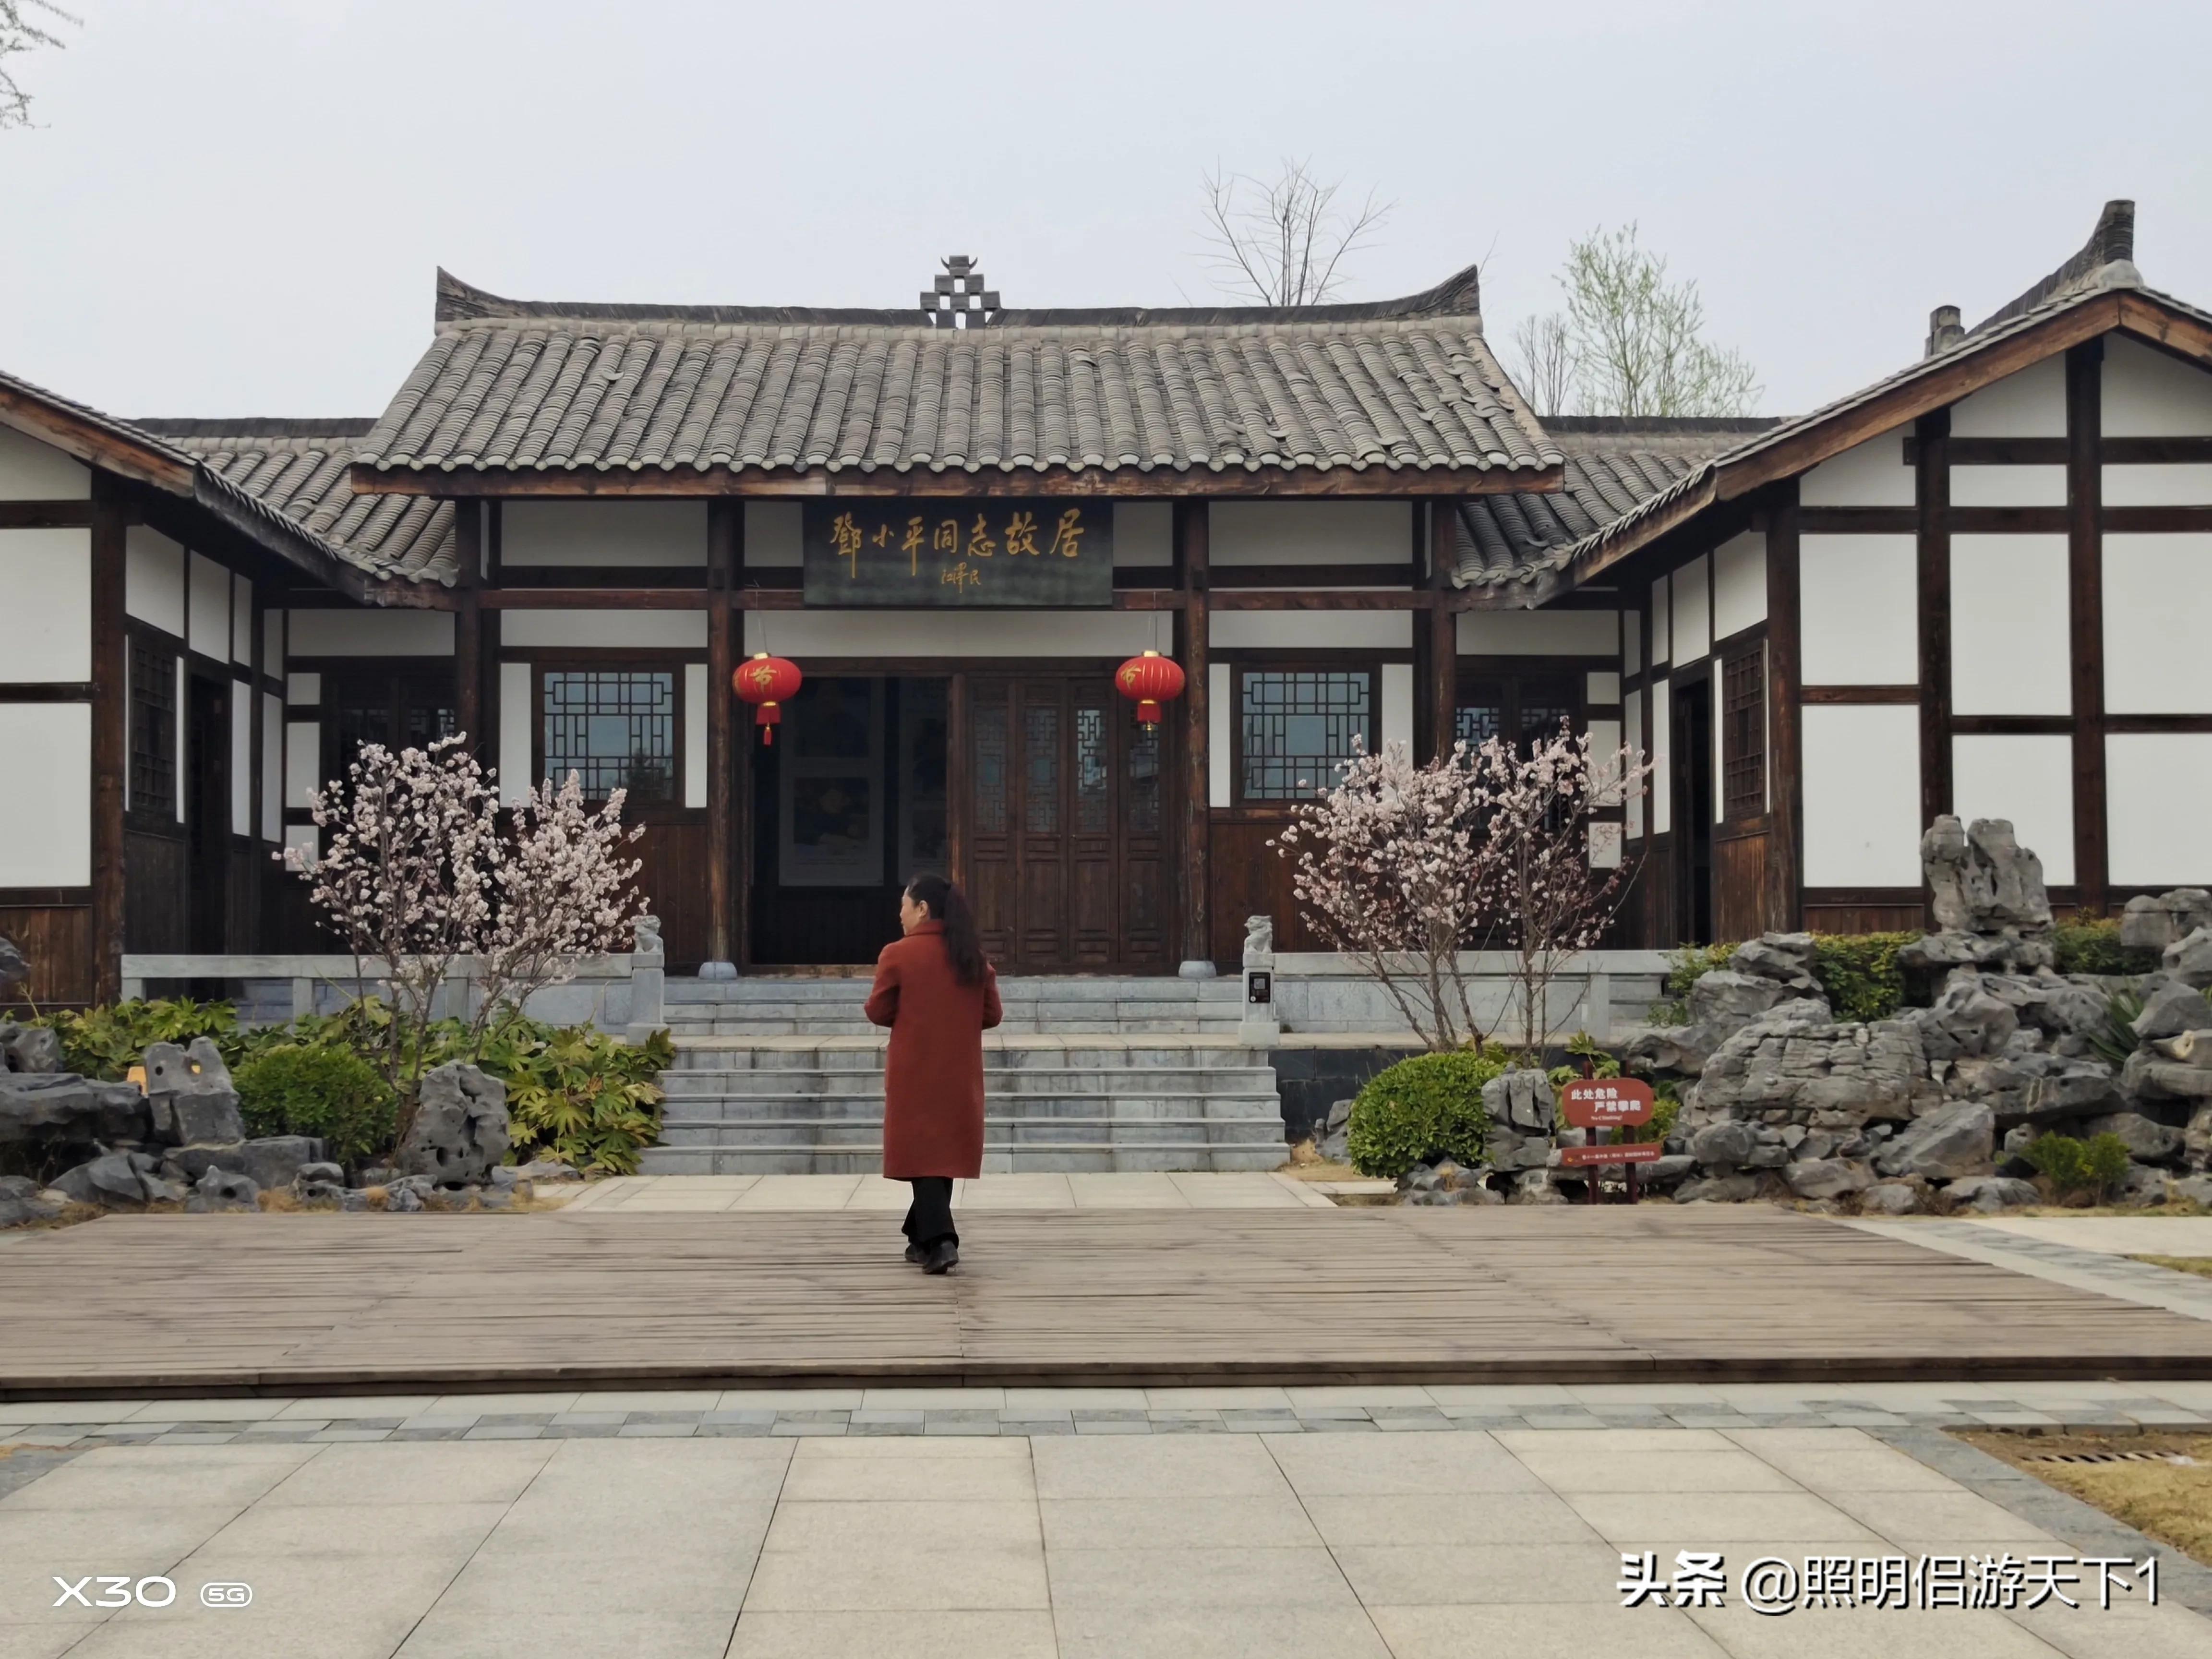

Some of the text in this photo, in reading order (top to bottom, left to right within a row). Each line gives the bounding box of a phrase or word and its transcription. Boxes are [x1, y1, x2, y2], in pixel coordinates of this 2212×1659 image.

[1571, 1087, 1618, 1100] 此处危险
[1594, 1100, 1641, 1113] 严禁攀爬
